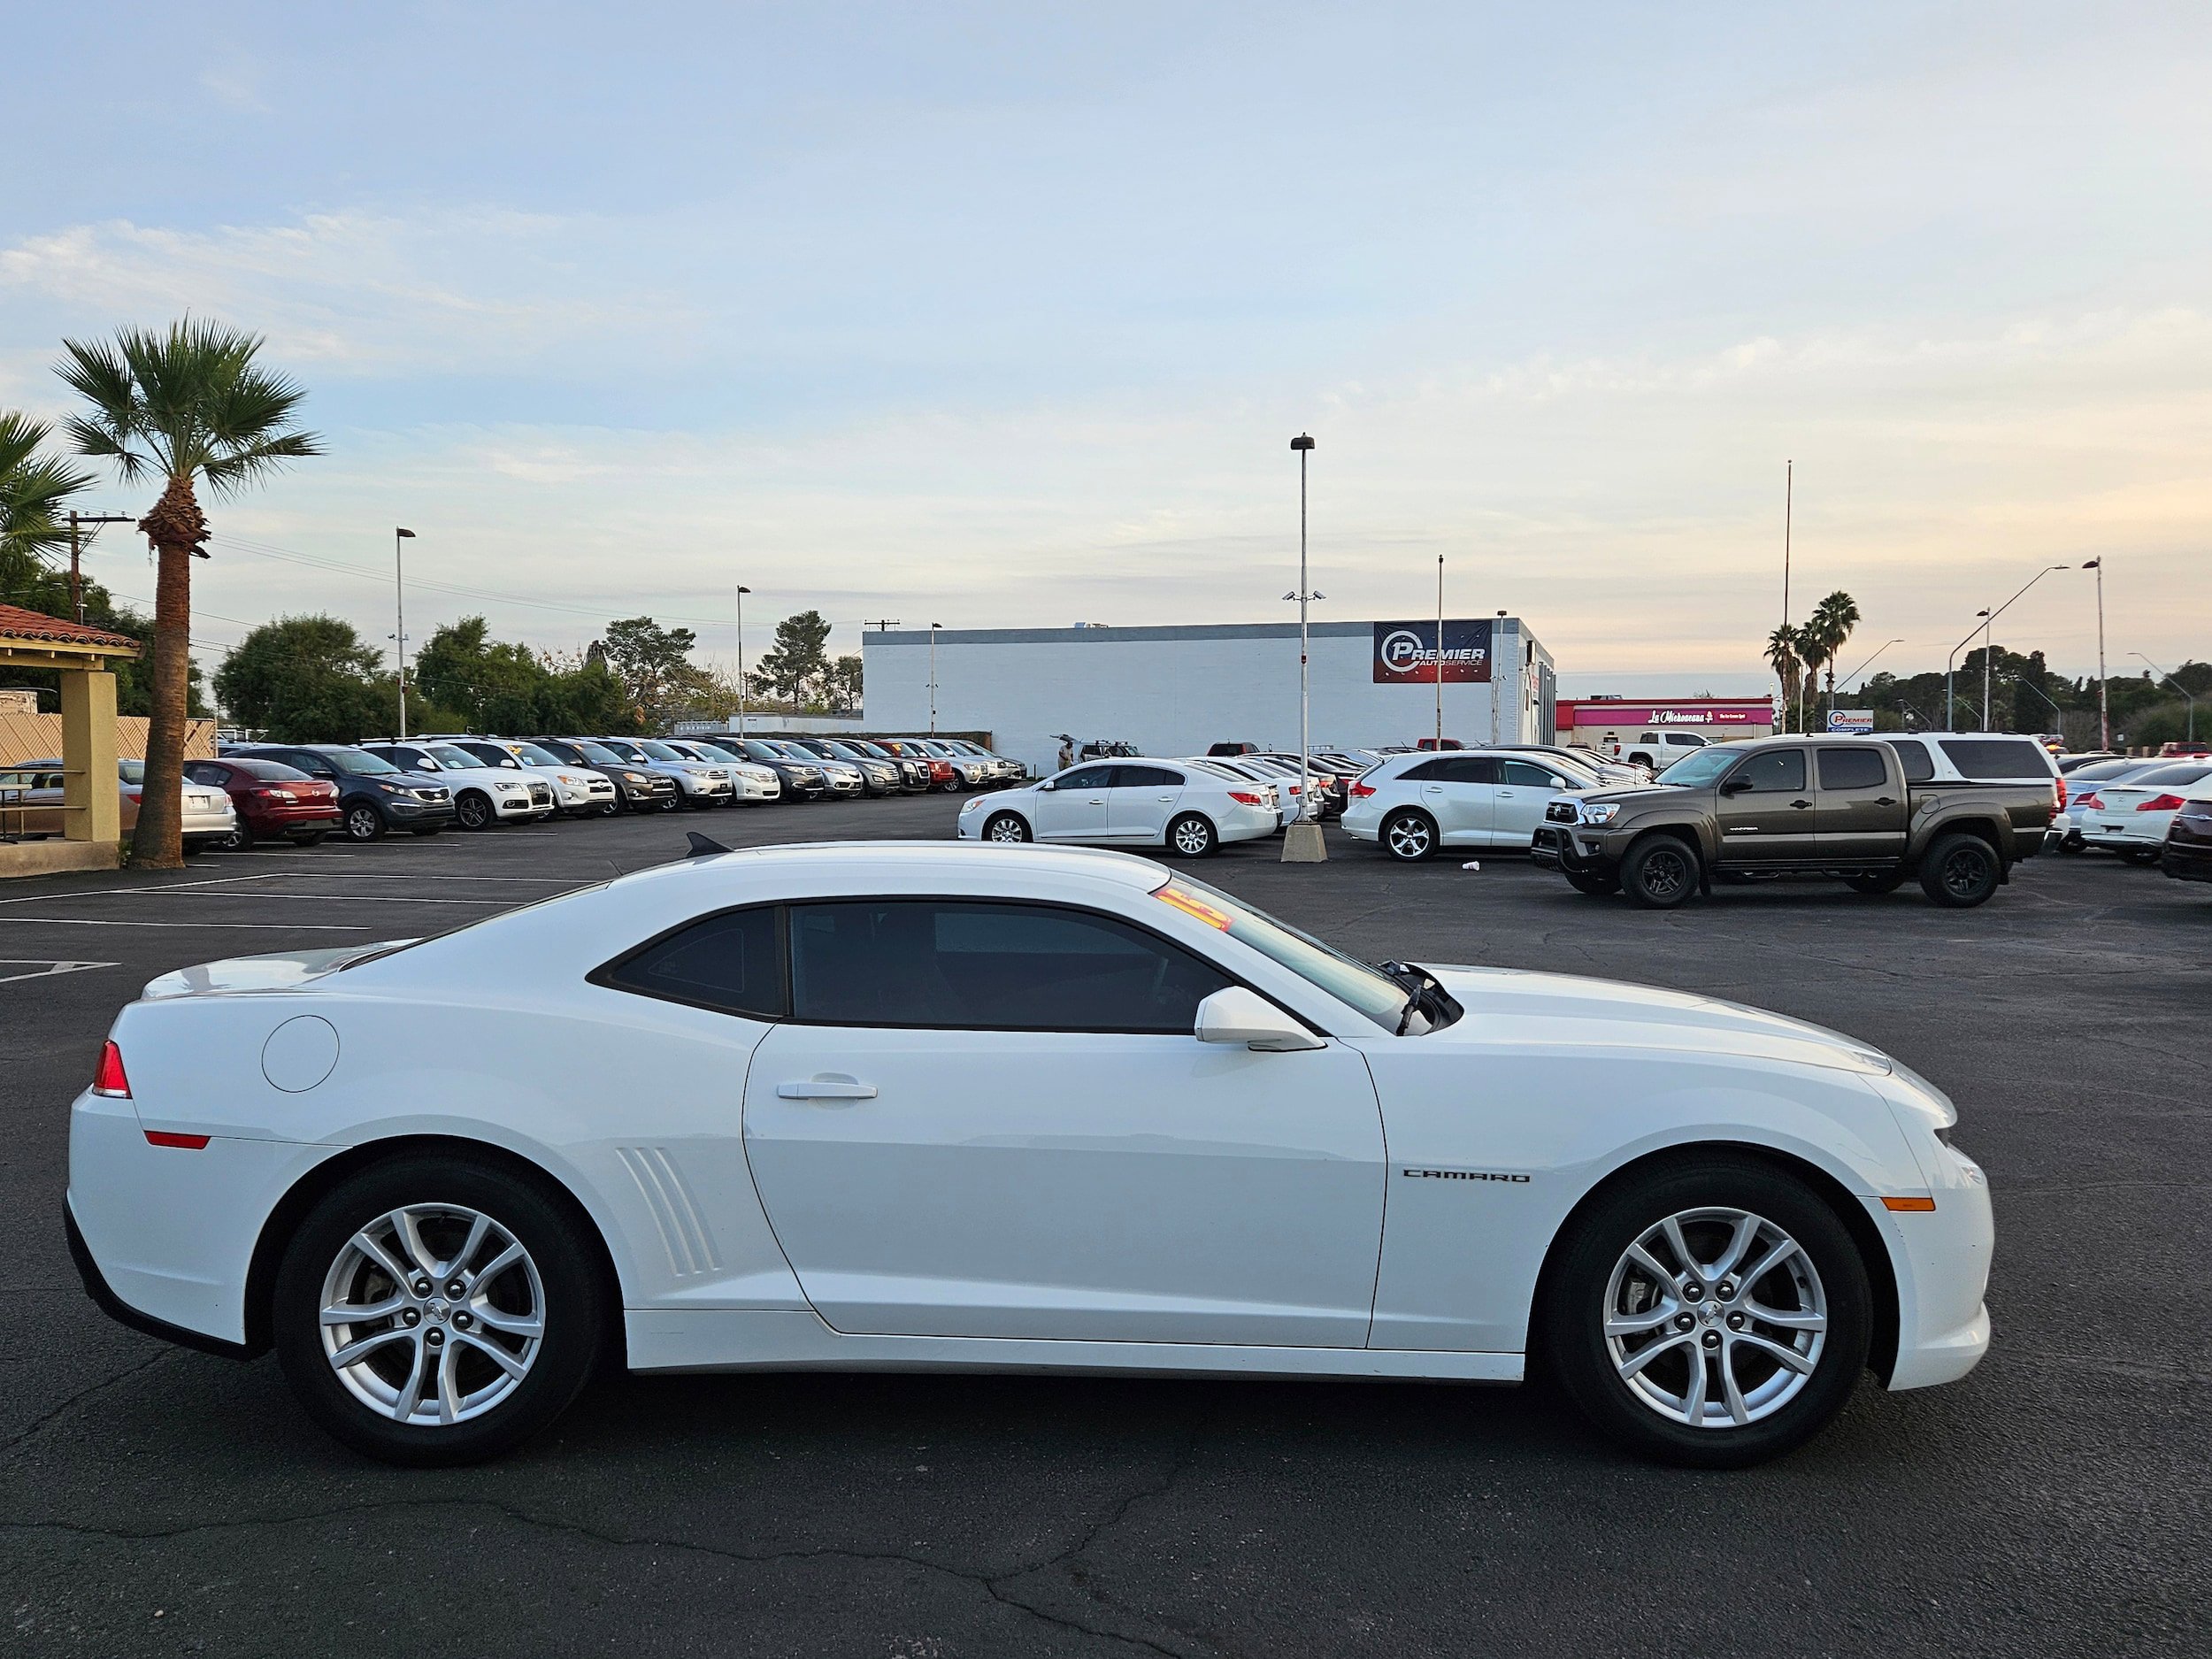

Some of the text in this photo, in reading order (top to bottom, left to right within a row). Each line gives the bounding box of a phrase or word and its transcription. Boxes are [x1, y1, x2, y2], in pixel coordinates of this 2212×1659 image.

[1392, 641, 1486, 660] PREMIER
[1647, 710, 1705, 724] La Michoacana
[1403, 1170, 1531, 1183] CAMARO
